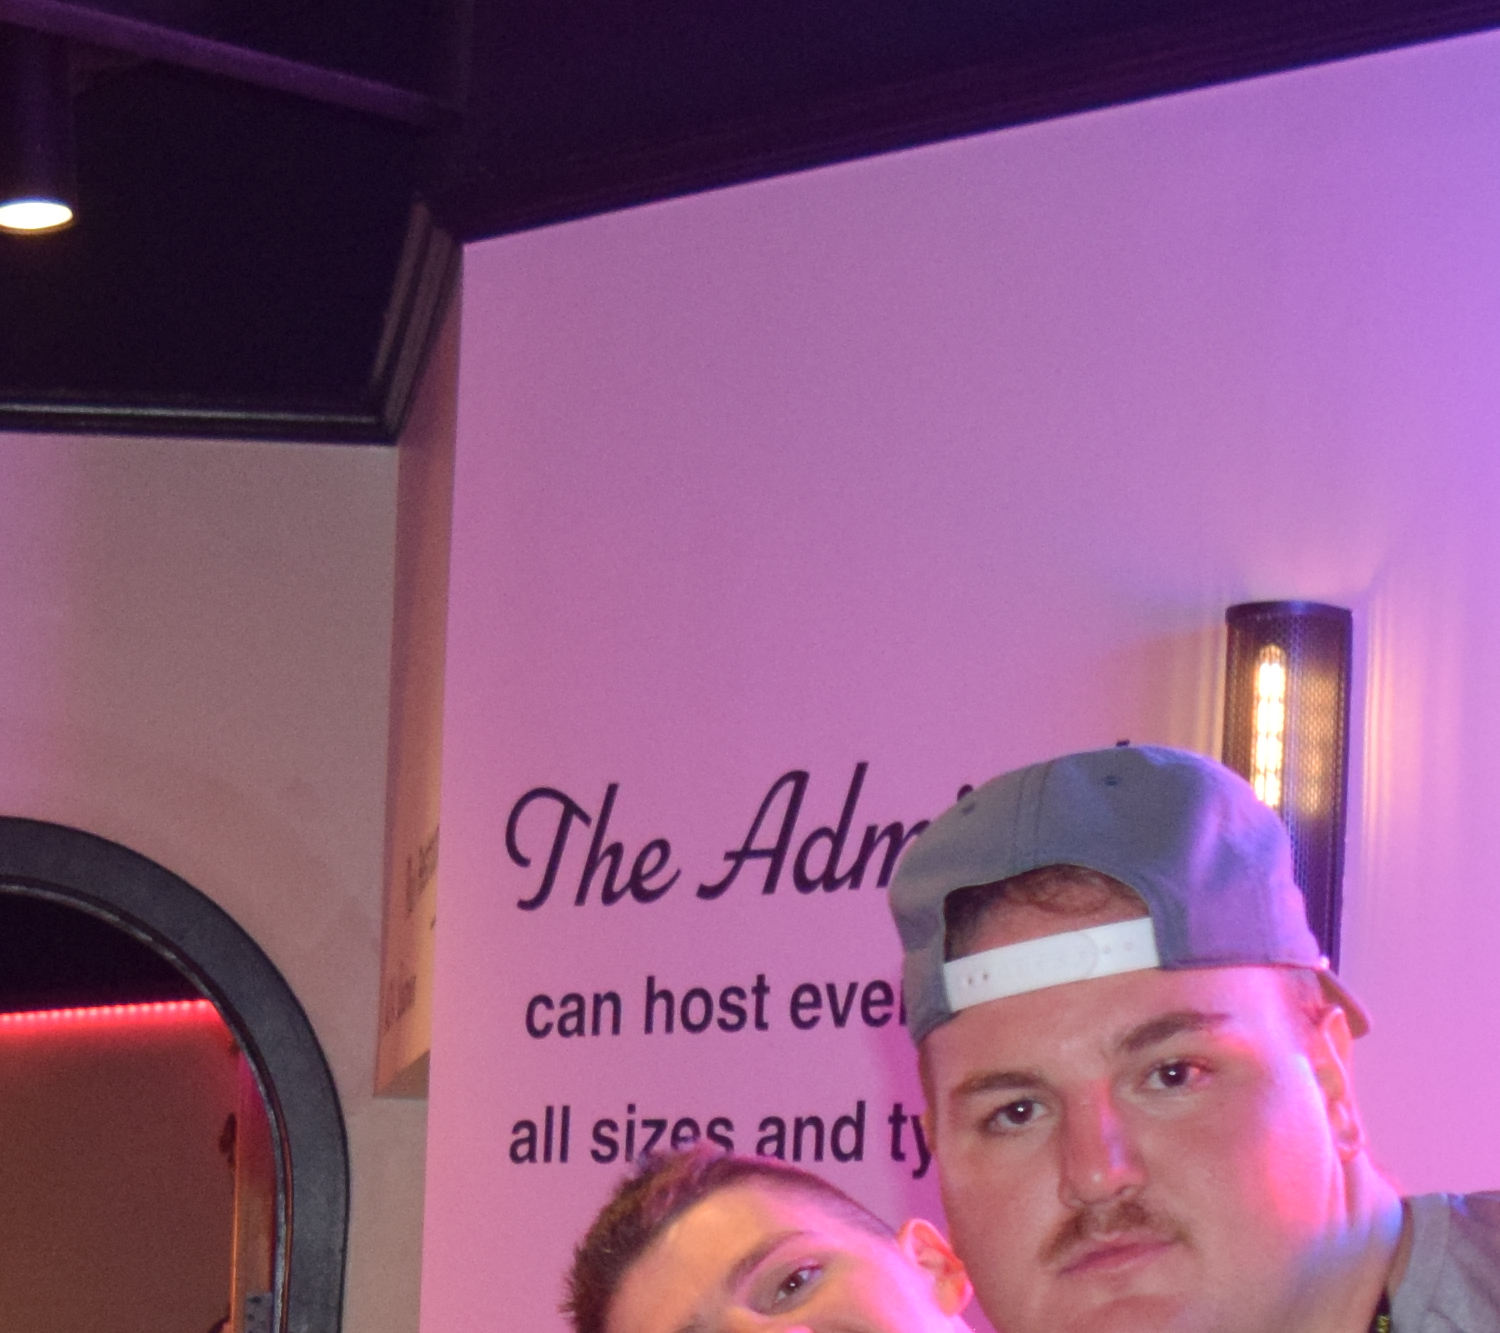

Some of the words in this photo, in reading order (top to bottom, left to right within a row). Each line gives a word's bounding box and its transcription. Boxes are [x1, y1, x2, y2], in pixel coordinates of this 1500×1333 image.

[505, 783, 681, 911] The
[696, 761, 975, 900] Adm
[525, 990, 621, 1039] can
[644, 974, 771, 1036] host
[789, 976, 909, 1031] eve
[508, 1104, 571, 1165] all
[590, 1103, 735, 1164] sizes
[756, 1100, 867, 1162] and
